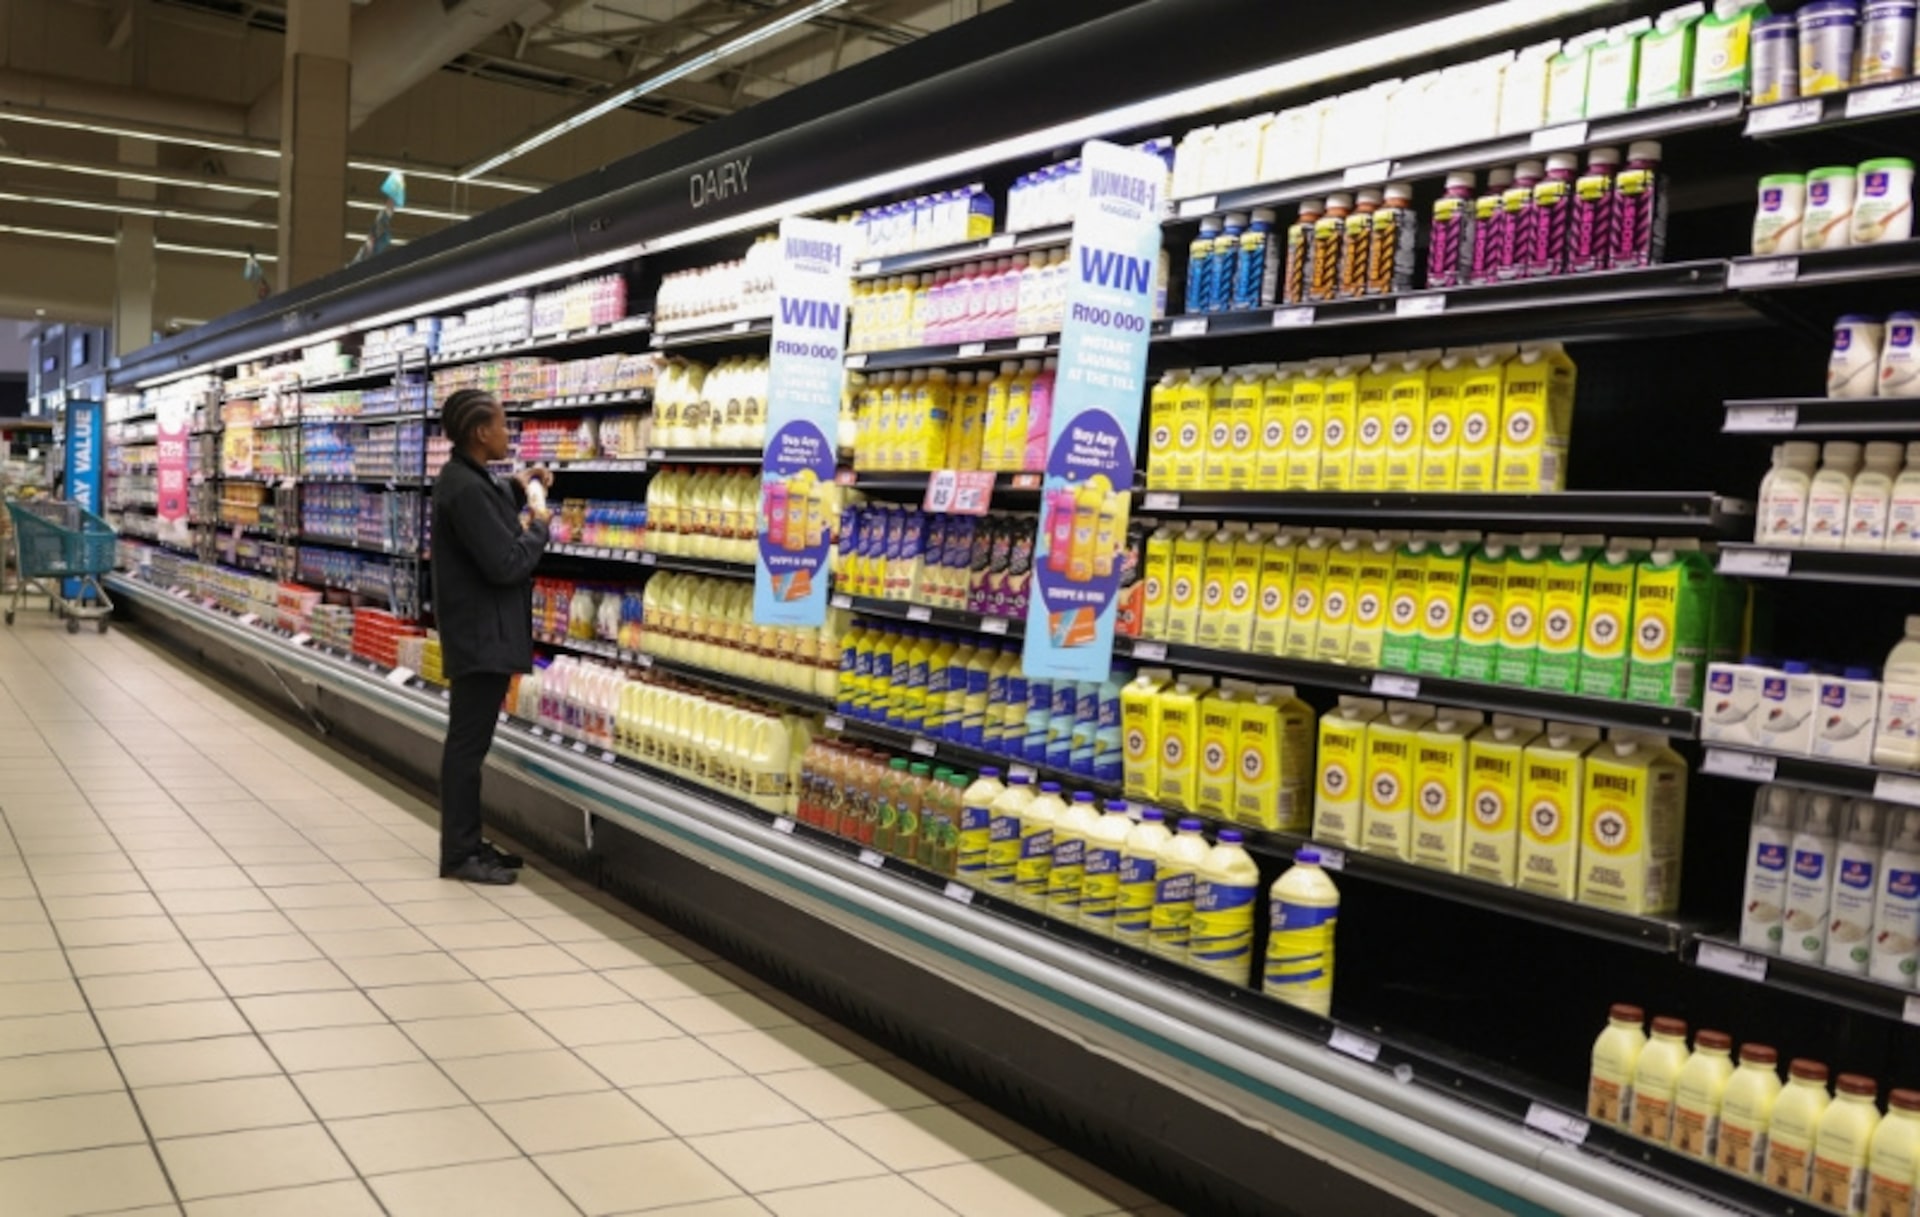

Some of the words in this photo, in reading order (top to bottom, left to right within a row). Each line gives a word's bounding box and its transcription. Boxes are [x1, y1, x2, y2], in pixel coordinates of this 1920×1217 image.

[690, 156, 752, 208] DAIRY
[1080, 246, 1151, 294] WIN
[780, 297, 841, 330] WIN
[1072, 303, 1111, 328] R100
[1114, 311, 1145, 333] 000
[776, 340, 808, 356] R100
[811, 345, 838, 360] 000
[74, 410, 92, 473] VALUE
